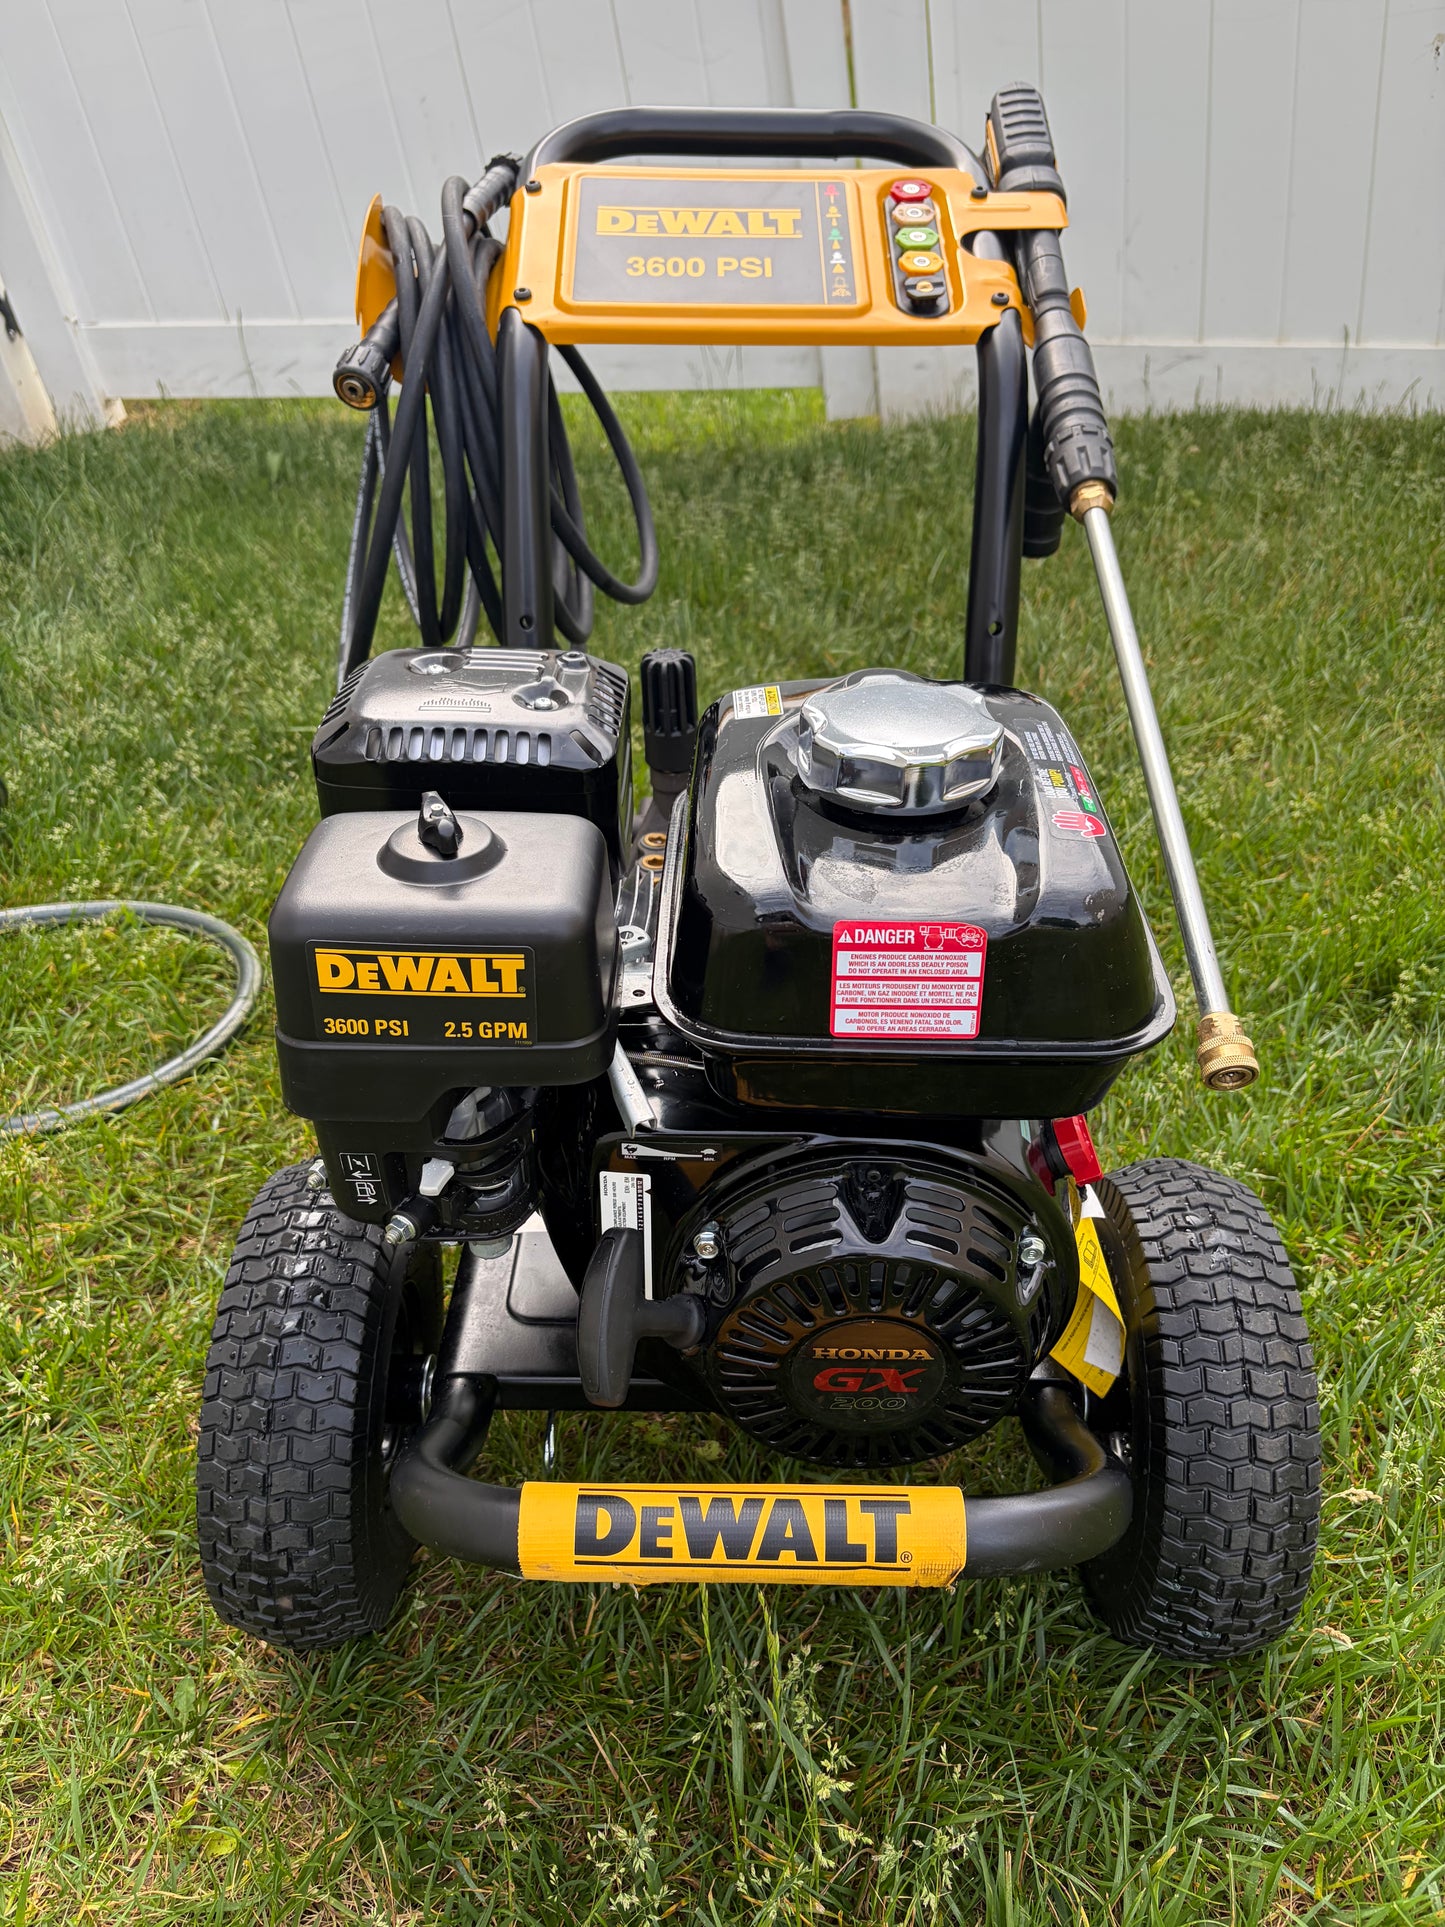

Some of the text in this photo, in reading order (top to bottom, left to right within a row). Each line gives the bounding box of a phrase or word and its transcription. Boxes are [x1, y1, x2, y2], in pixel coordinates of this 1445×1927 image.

[626, 256, 773, 278] 3600 PSI
[855, 929, 915, 944] DANGER
[324, 1018, 409, 1036] 3600 PSI
[445, 1022, 527, 1039] 2.5 GPM
[812, 1348, 934, 1360] HONDA
[814, 1368, 928, 1393] GX
[830, 1397, 907, 1410] 200
